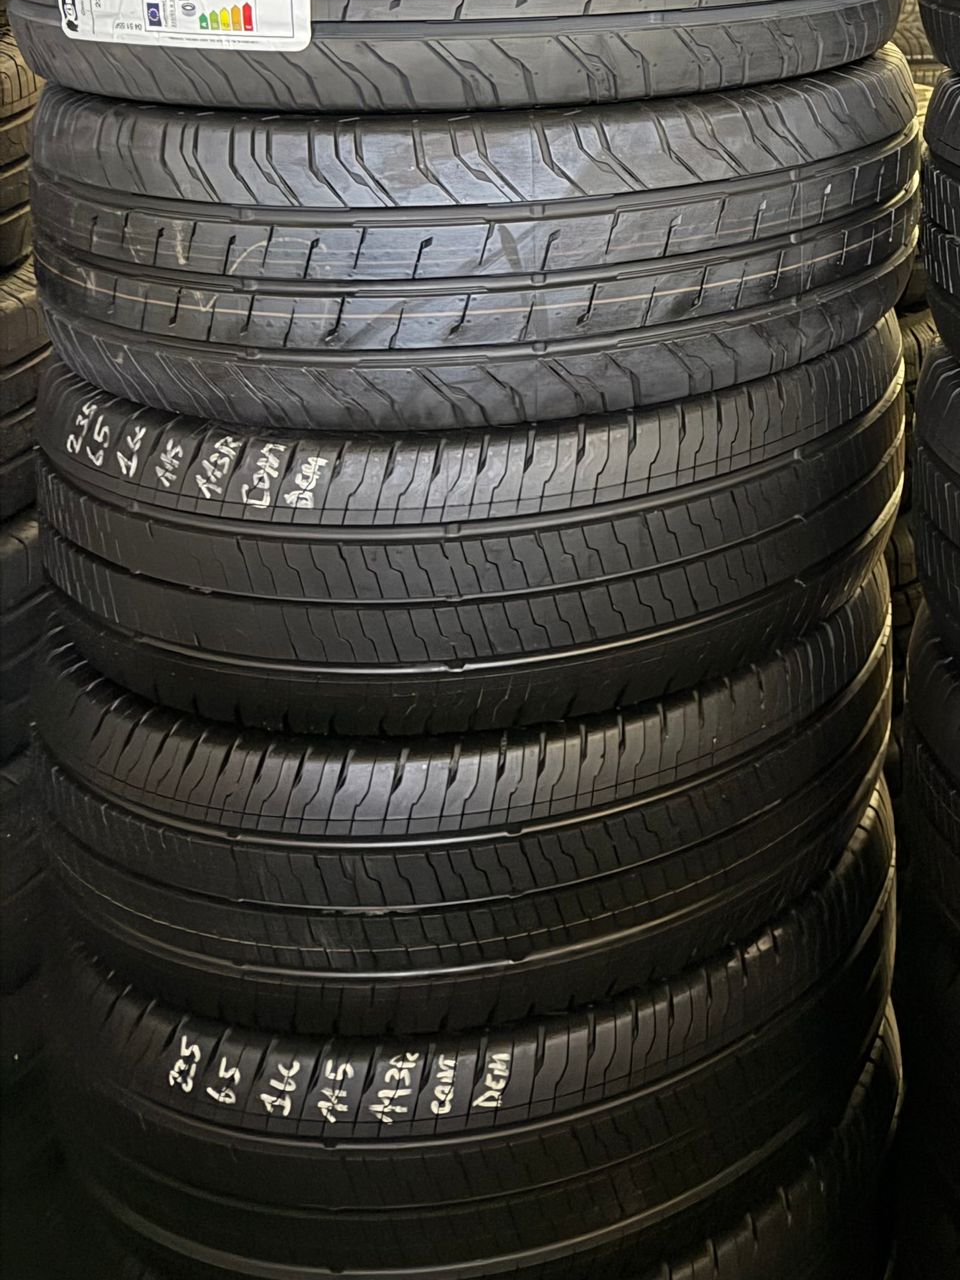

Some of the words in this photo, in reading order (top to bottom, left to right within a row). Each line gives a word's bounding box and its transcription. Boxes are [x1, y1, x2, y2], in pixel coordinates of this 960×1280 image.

[66, 402, 98, 454] 235
[86, 415, 110, 467] 65
[155, 438, 183, 487] 115
[169, 1035, 200, 1093] 235
[206, 1056, 241, 1104] 65
[260, 1060, 300, 1117] 16C
[317, 1058, 354, 1123] 115
[369, 1052, 419, 1124] 113R
[472, 1053, 510, 1109] DEM
